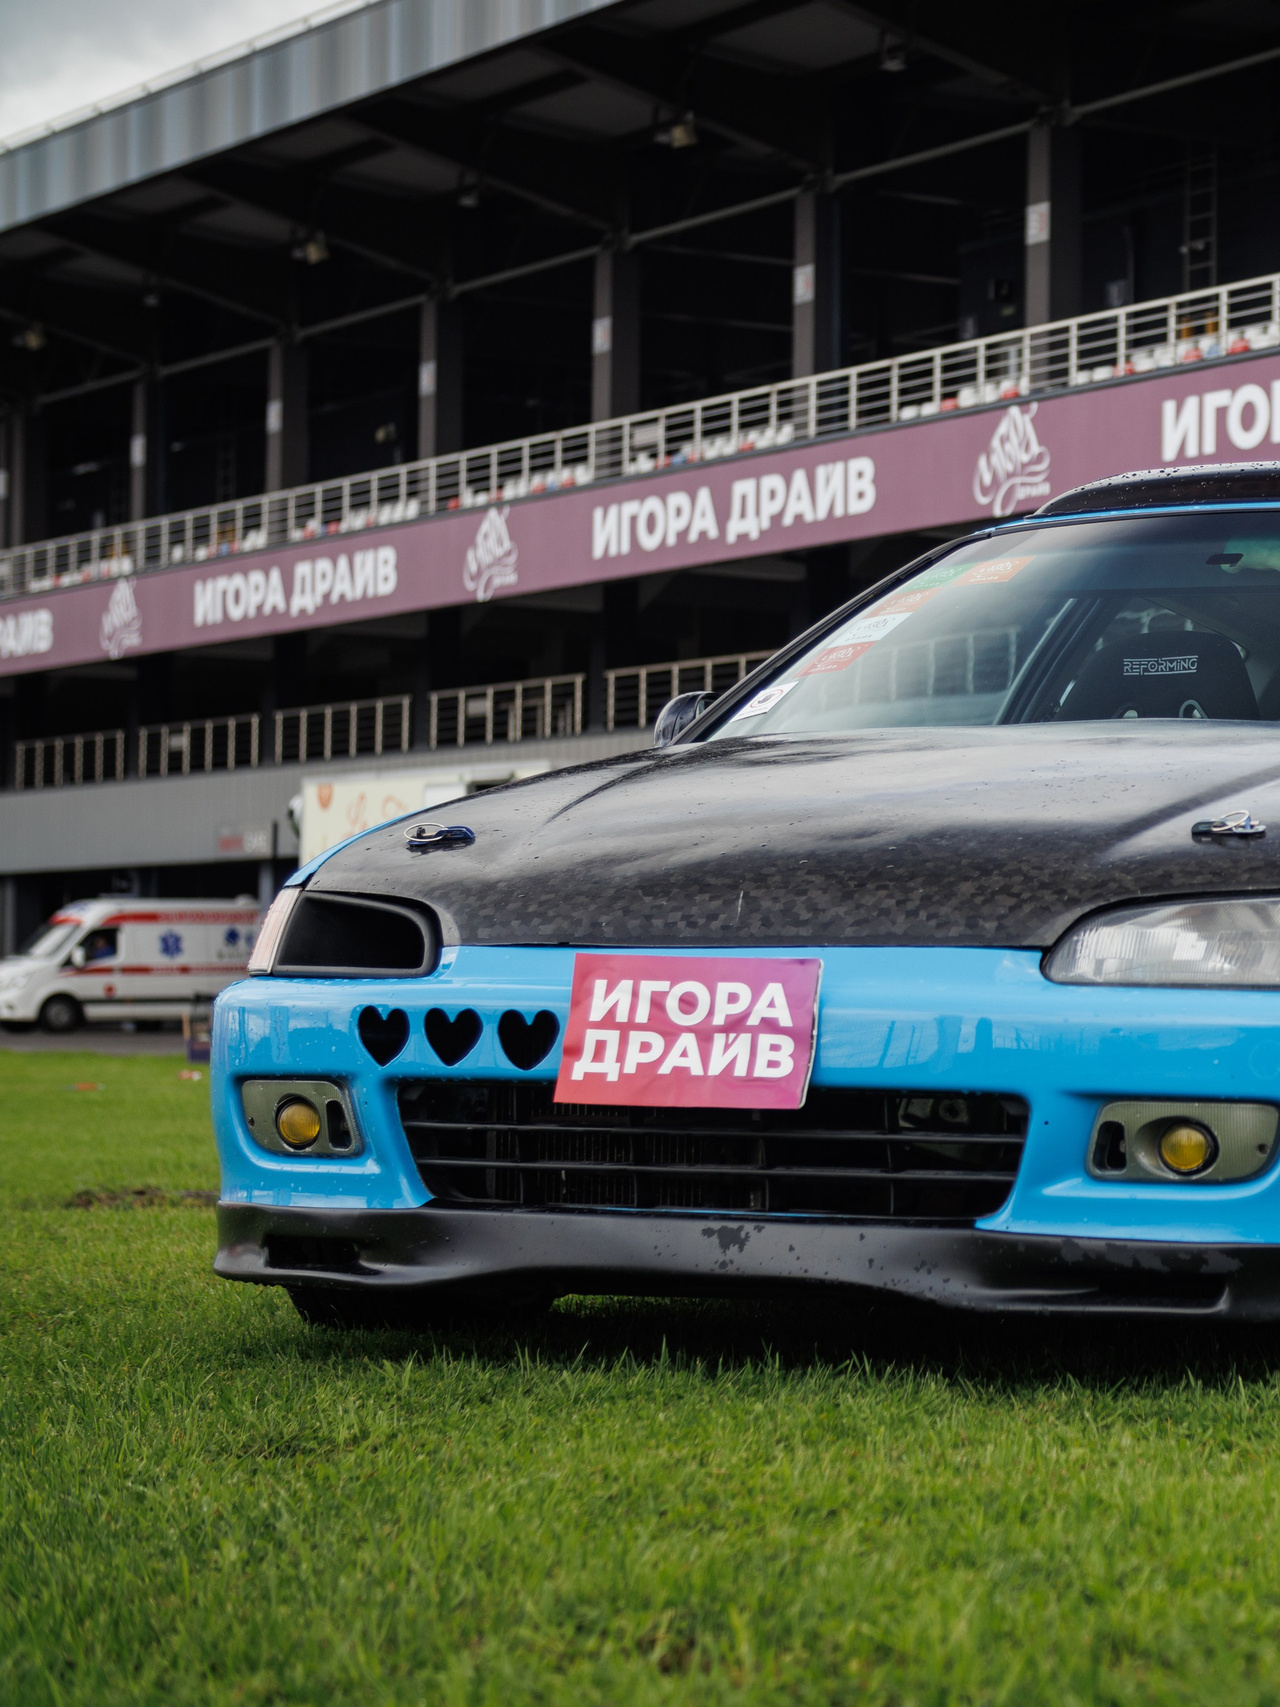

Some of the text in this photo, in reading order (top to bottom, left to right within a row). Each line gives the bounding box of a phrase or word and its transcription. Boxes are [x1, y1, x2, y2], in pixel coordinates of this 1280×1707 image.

[592, 456, 877, 560] ИГОРА ДРАЙВ
[193, 565, 287, 627] ИГОРА
[290, 545, 398, 617] ДРАЙВ
[589, 979, 793, 1027] ИГОРА
[571, 1029, 795, 1082] ДРАЙВ
